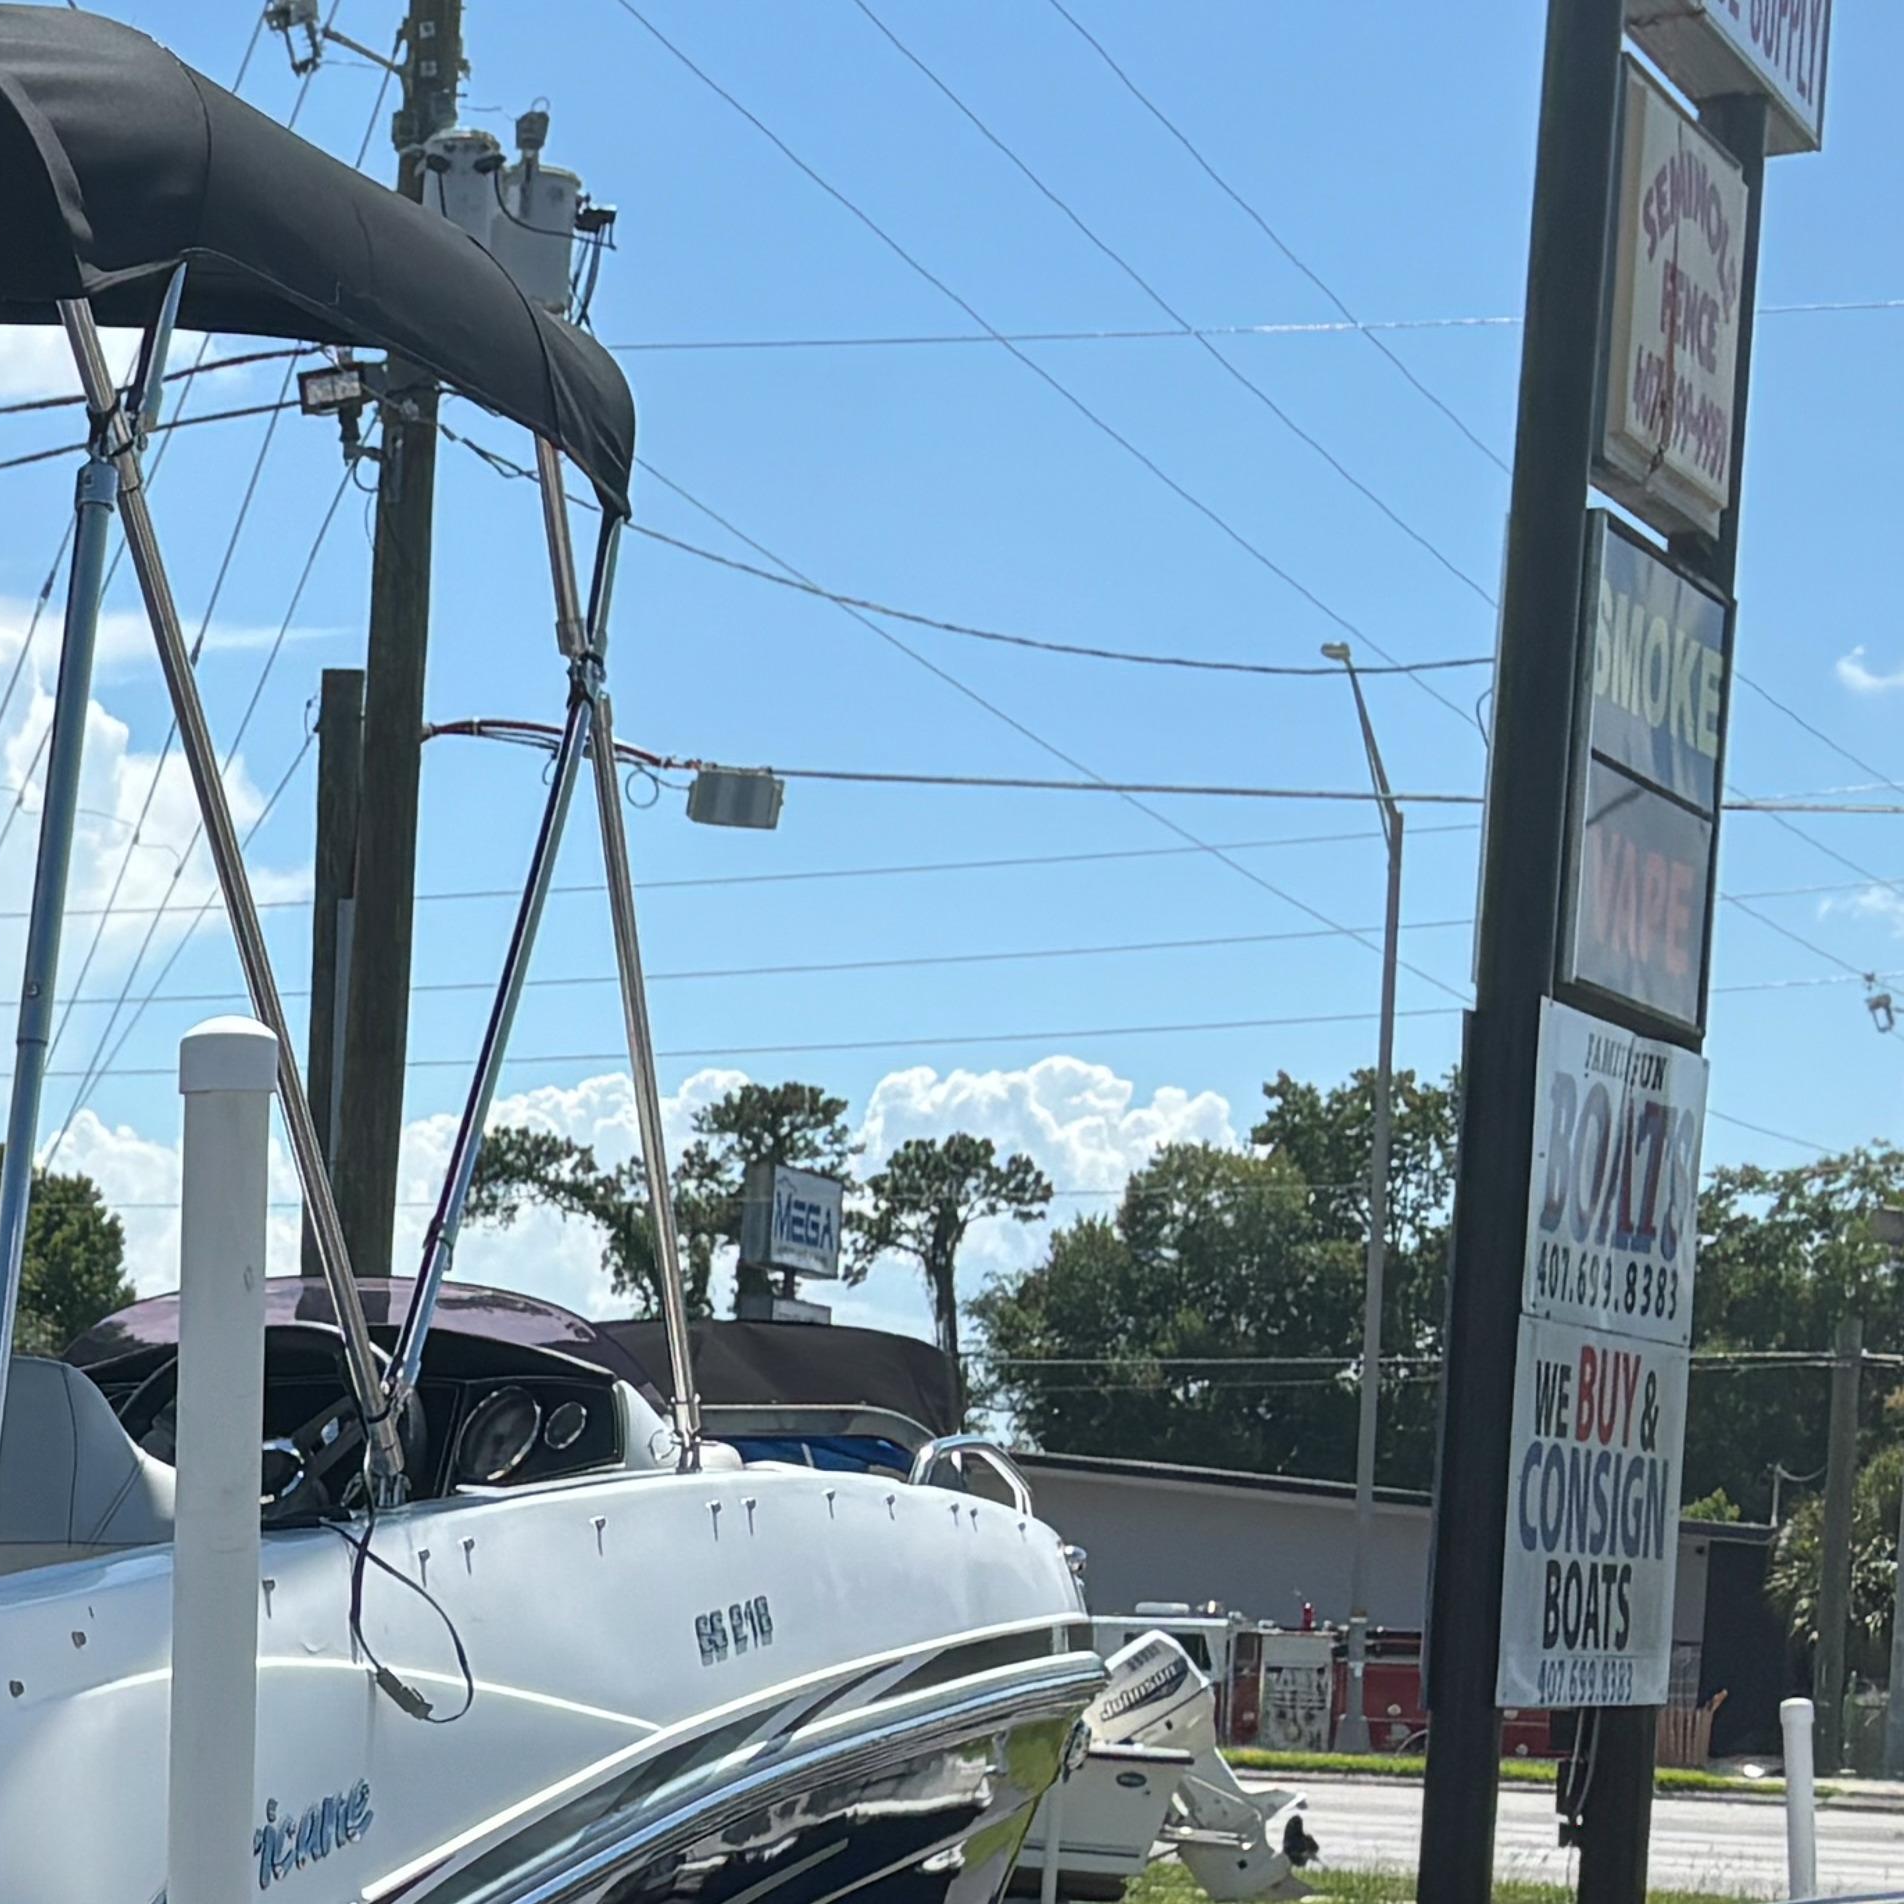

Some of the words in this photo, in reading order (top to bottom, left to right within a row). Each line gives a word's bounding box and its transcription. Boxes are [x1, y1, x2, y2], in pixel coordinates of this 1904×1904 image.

[1660, 259, 1720, 374] FENCE
[1593, 579, 1723, 757] SMOKE
[1591, 822, 1695, 978] VAPE
[774, 1191, 834, 1253] MEGA
[1541, 1072, 1696, 1263] BOATS
[1535, 1359, 1572, 1436] WE
[1575, 1344, 1643, 1448] BUY
[1637, 1370, 1660, 1452] &
[1518, 1441, 1670, 1561] CONSIGN
[1542, 1560, 1632, 1653] BOATS
[1100, 1662, 1179, 1721] Johnson
